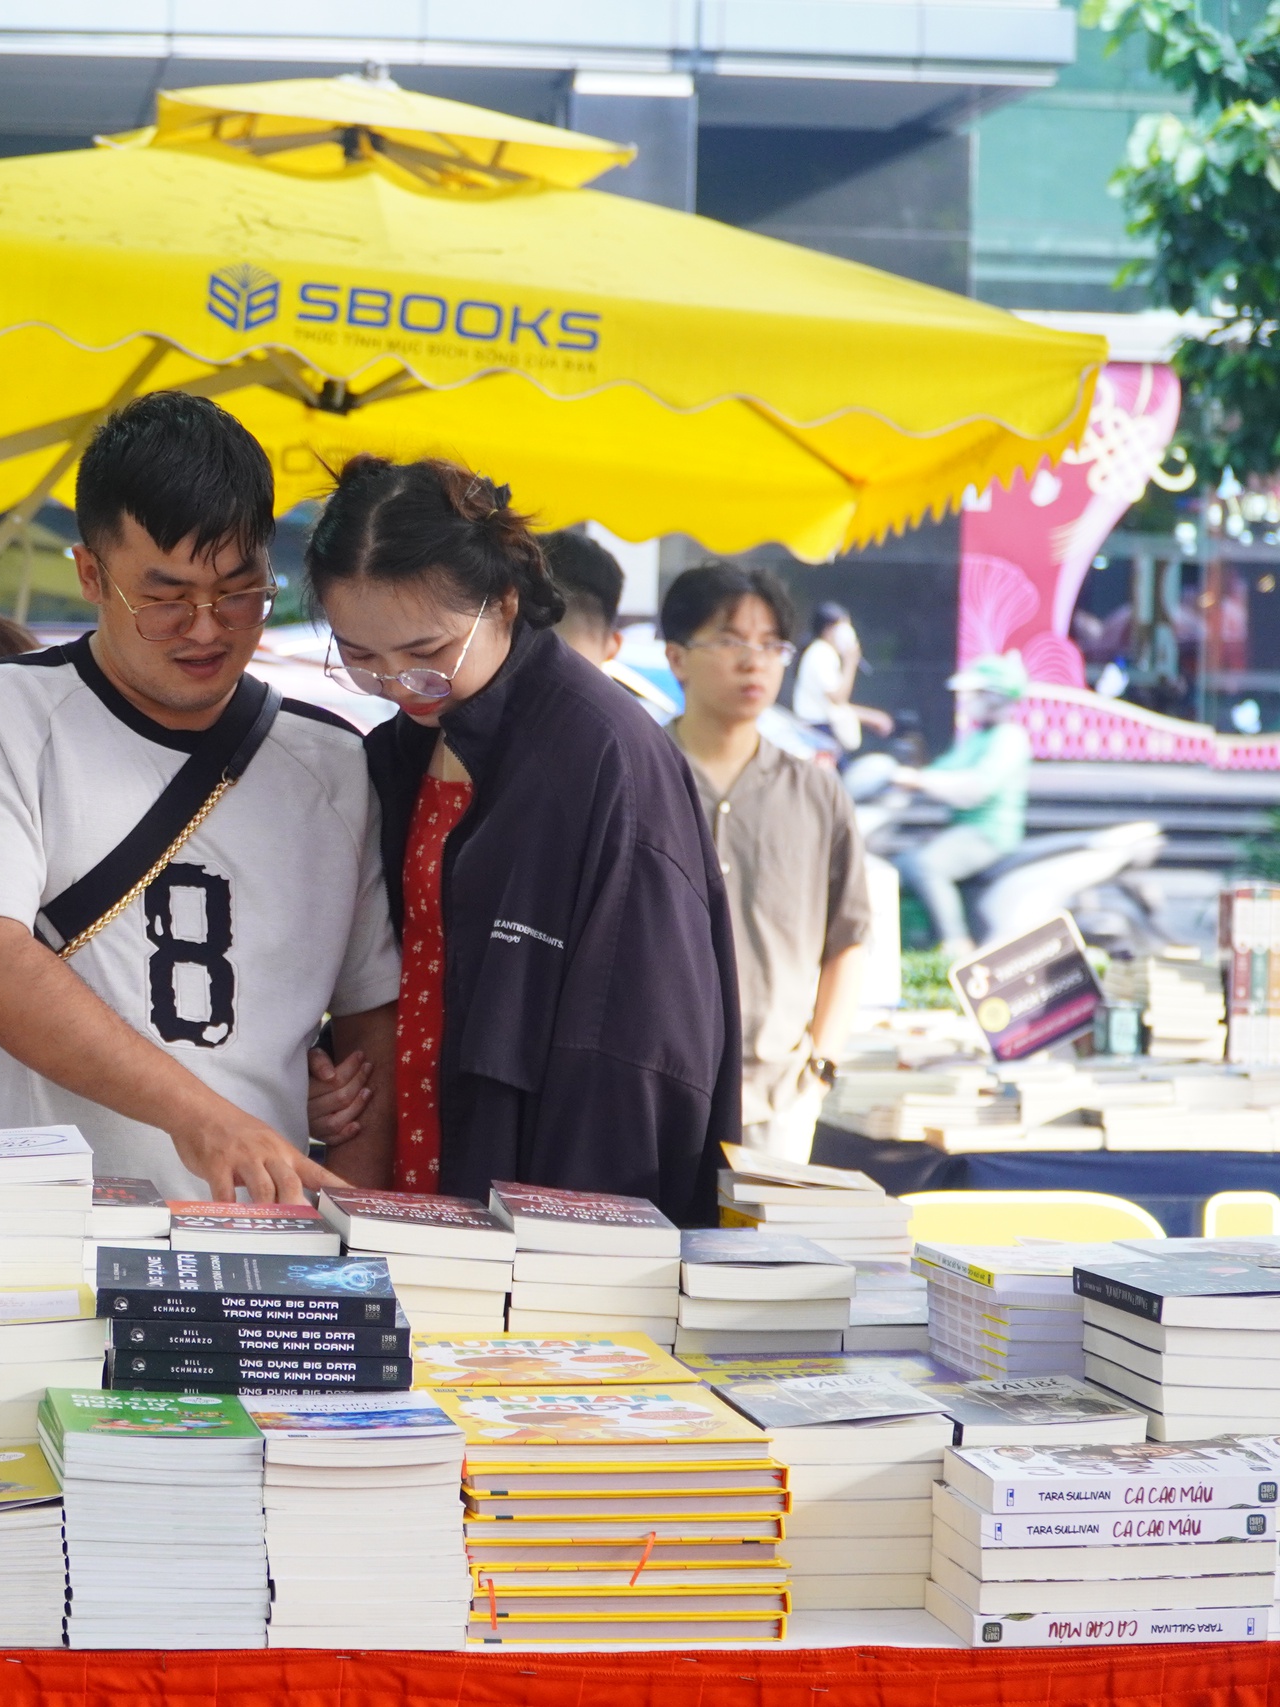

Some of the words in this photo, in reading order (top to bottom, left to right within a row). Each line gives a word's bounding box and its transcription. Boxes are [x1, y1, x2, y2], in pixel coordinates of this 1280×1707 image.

[297, 281, 601, 353] SBOOKS
[143, 862, 233, 1047] 8
[222, 1298, 246, 1307] ỨNG
[250, 1299, 282, 1310] DỤNG
[286, 1300, 305, 1308] BIG
[309, 1301, 339, 1310] DATA
[153, 1306, 197, 1314] SCHMARZO
[223, 1310, 262, 1318] TRONG
[266, 1311, 294, 1319] KINH
[297, 1312, 338, 1321] DOANH
[238, 1329, 262, 1338] ỨNG
[266, 1330, 298, 1340] DỤNG
[302, 1331, 321, 1339] BIG
[325, 1332, 356, 1340] DATA
[239, 1341, 279, 1349] TRONG
[283, 1342, 310, 1350] KINH
[314, 1343, 354, 1351] DOANH
[414, 1340, 615, 1349] HUMAN
[451, 1348, 591, 1356] BODY
[170, 1366, 214, 1374] SCHMARZO
[239, 1359, 263, 1368] ỨNG
[267, 1360, 299, 1370] DỤNG
[303, 1361, 322, 1369] BIG
[326, 1362, 357, 1370] DATA
[241, 1371, 280, 1379] TRONG
[284, 1372, 311, 1380] KINH
[315, 1373, 355, 1382] DOANH
[456, 1395, 674, 1403] HUMAN
[498, 1403, 649, 1411] BODY
[1038, 1491, 1065, 1502] TARA
[1066, 1490, 1111, 1501] SULLIVAN
[1124, 1487, 1145, 1504] CA
[1148, 1485, 1177, 1504] CAO
[1180, 1482, 1213, 1503] MÁU
[1027, 1526, 1053, 1535] TARA
[1054, 1524, 1100, 1534] SULLIVAN
[1112, 1521, 1133, 1538] CA
[1136, 1519, 1165, 1538] CAO
[1169, 1515, 1202, 1536] MÁU
[1048, 1621, 1083, 1643] MÁU
[1086, 1620, 1114, 1638] CAO
[1119, 1620, 1138, 1637] CA
[1151, 1623, 1194, 1633] SULLIVAN
[1195, 1623, 1223, 1632] TARA
